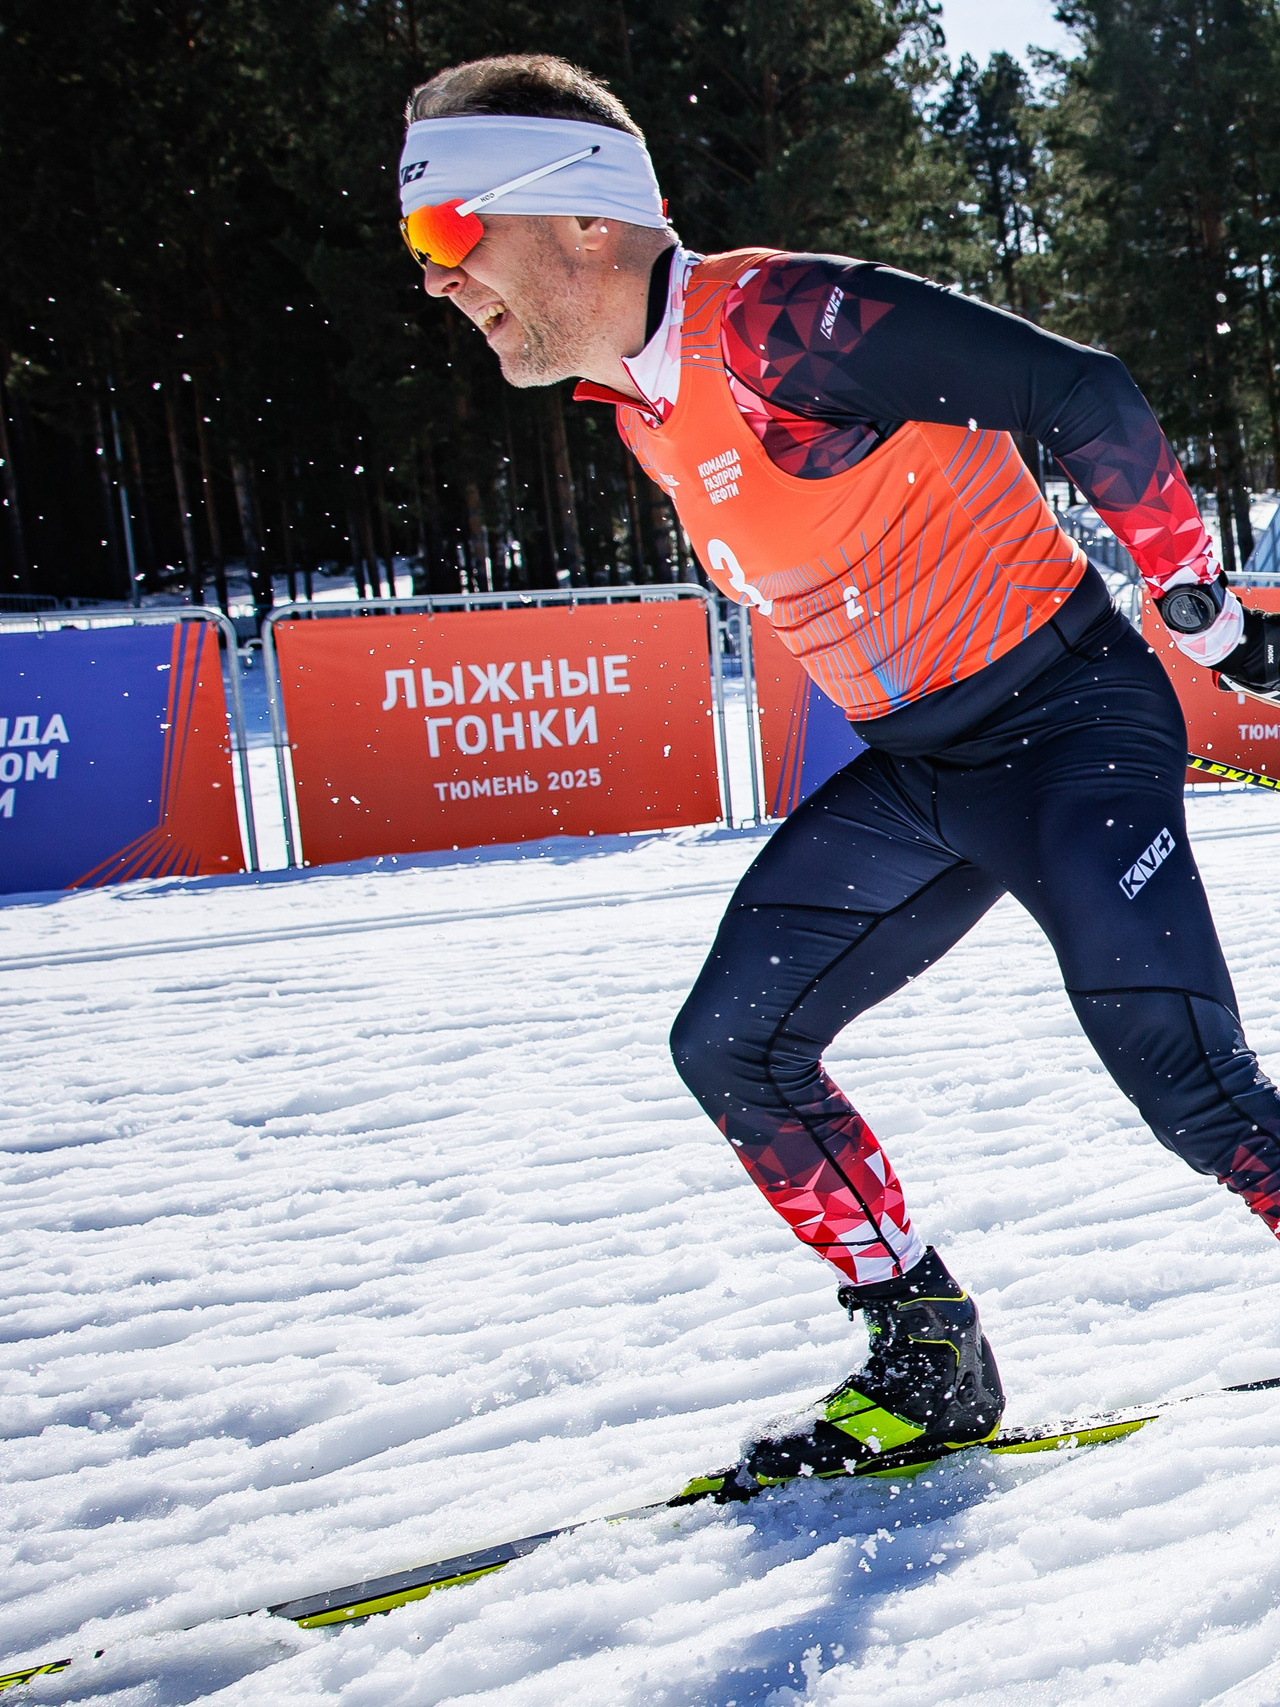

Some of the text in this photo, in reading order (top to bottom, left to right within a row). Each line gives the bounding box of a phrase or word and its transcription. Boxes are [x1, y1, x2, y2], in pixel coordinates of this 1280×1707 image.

[697, 447, 741, 478] КОМАНДА
[703, 463, 743, 492] ГАЗПРОМ
[709, 481, 740, 505] НЕФТИ
[842, 585, 865, 620] 2
[382, 654, 631, 711] ЛЫЖНЫЕ
[425, 705, 599, 758] ГОНКИ
[433, 767, 602, 802] ТЮМЕНЬ 2025
